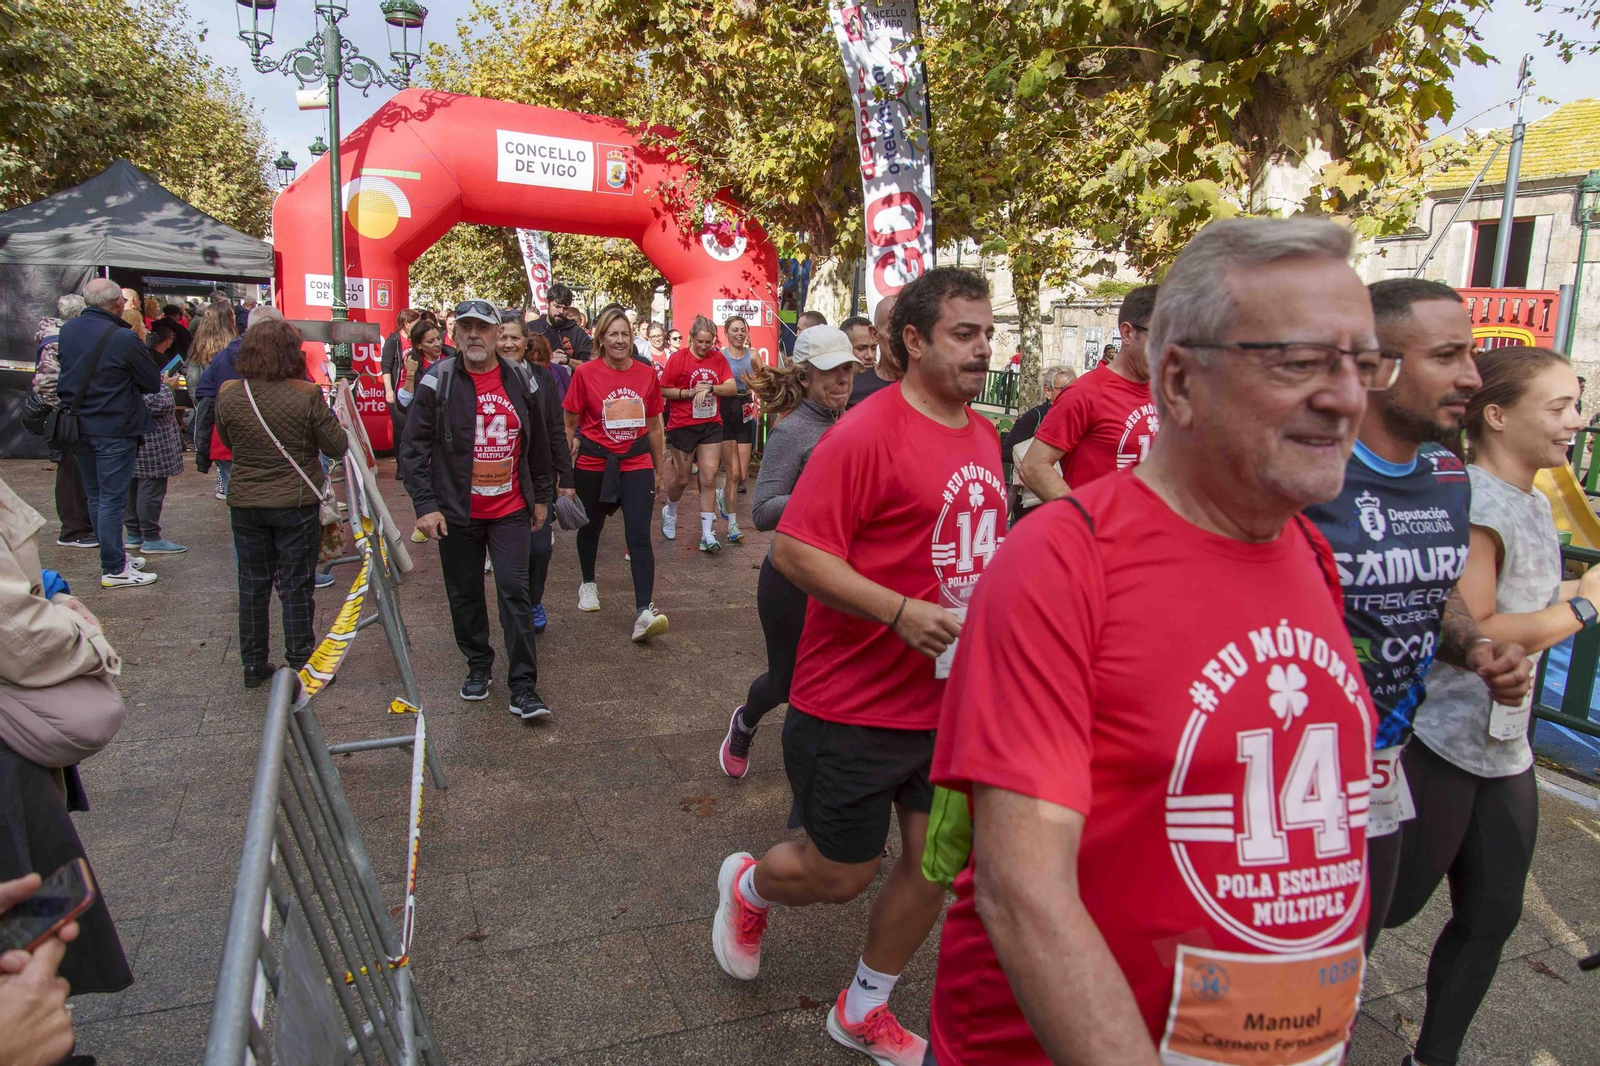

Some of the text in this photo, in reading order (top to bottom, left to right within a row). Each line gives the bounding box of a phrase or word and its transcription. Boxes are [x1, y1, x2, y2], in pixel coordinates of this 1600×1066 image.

[864, 9, 907, 20] CONCELLO
[858, 65, 876, 182] deporte
[505, 141, 586, 163] CONCELLO
[515, 159, 578, 178] DE VIGO
[866, 191, 925, 296] GO
[310, 281, 364, 292] CONLLO
[316, 291, 330, 299] DE
[716, 304, 759, 313] CONCELLO
[474, 415, 509, 446] 14
[942, 461, 1008, 504] #EU MÓVOME
[1386, 505, 1450, 525] Deputación
[1392, 519, 1454, 536] DA CORUÑA
[956, 508, 998, 574] 14
[1334, 544, 1470, 587] SAMURA
[947, 576, 968, 588] POLA
[1188, 641, 1249, 713] #EU
[1235, 722, 1351, 867] 14
[1215, 858, 1362, 900] POLA ESCLEROSE
[1252, 892, 1346, 928] MÚLTIPLE
[1243, 1007, 1322, 1032] Manuel
[1202, 1033, 1270, 1051] Carnero
